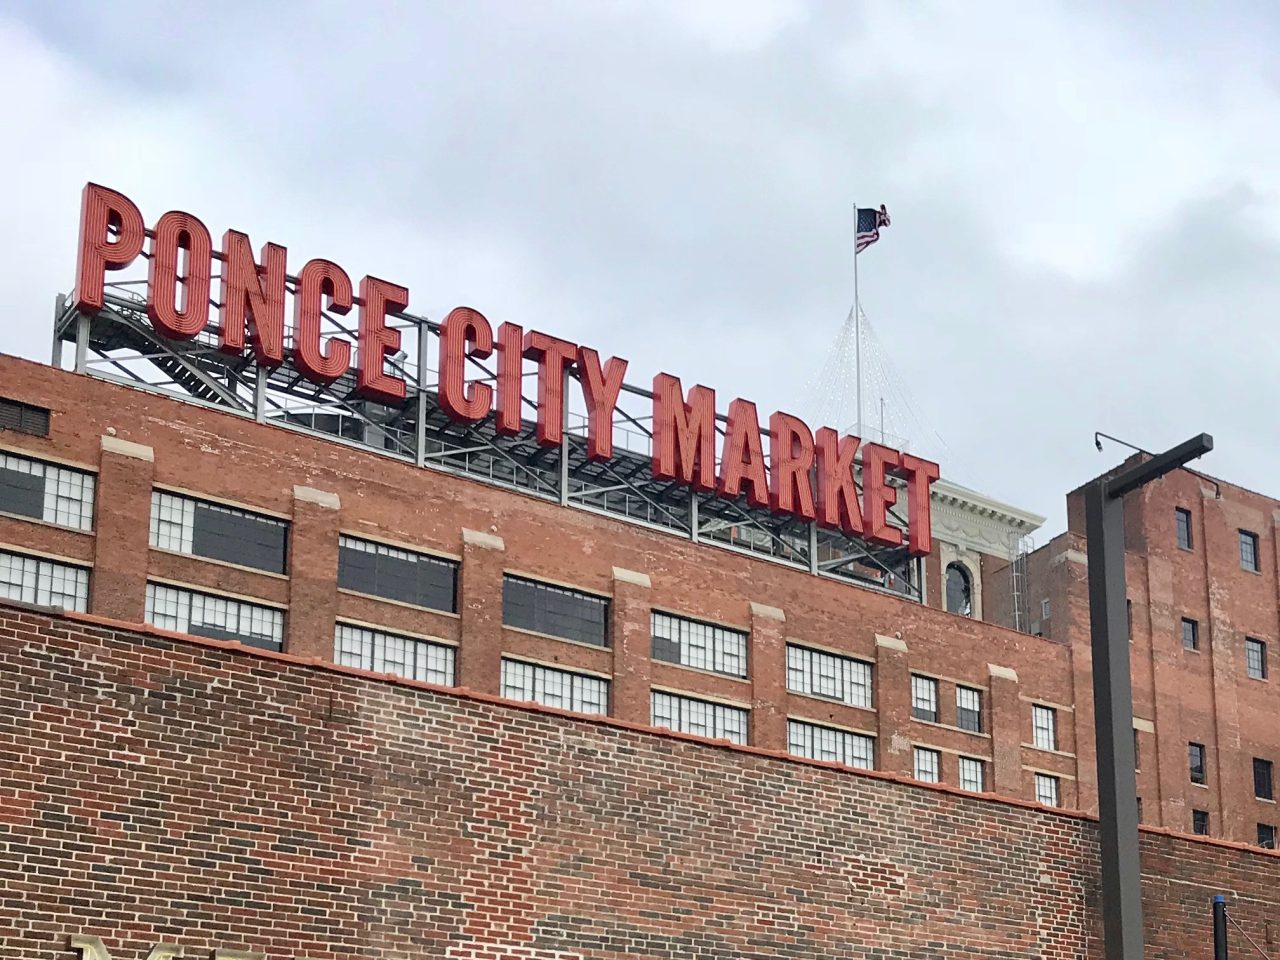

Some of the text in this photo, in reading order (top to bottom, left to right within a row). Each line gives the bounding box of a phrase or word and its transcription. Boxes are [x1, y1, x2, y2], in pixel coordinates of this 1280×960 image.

[75, 182, 940, 557] PONCE CITY MARKET
